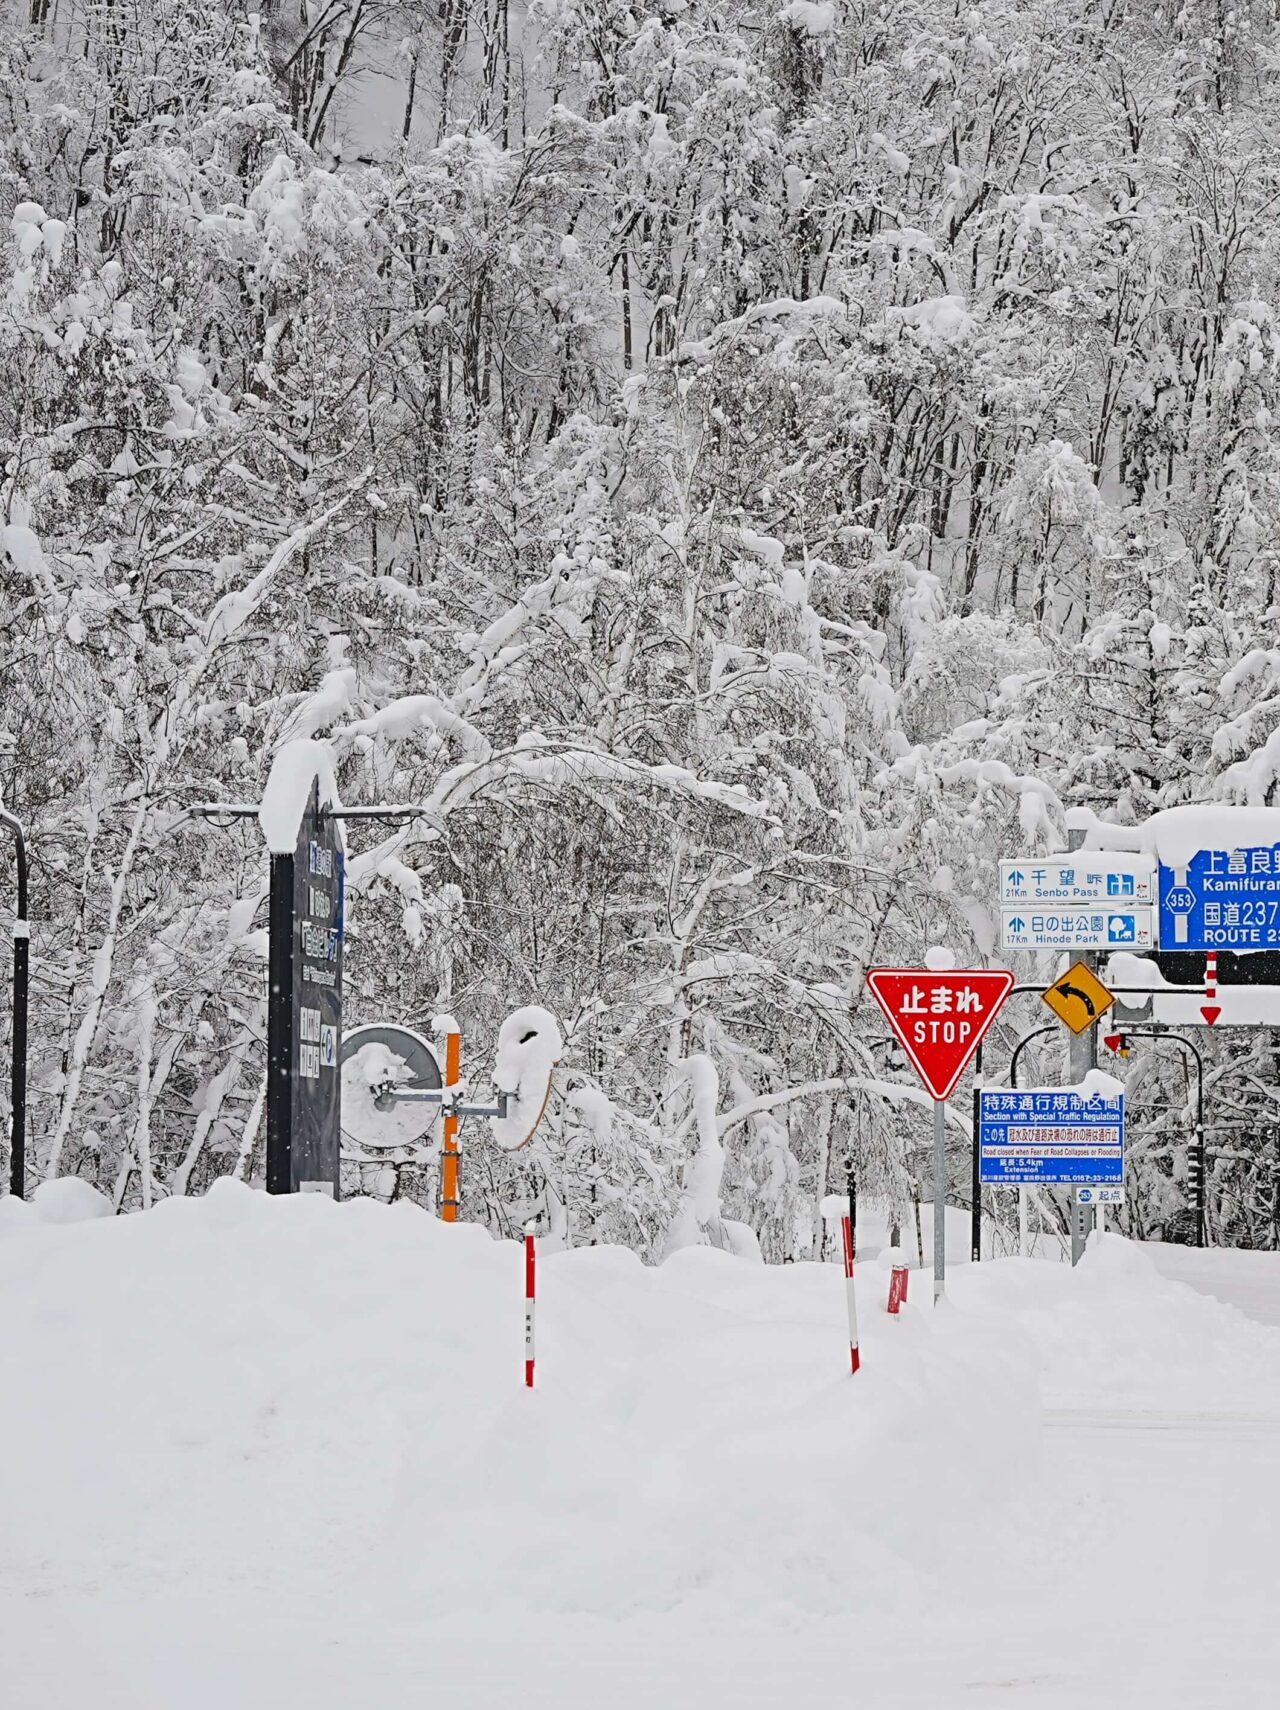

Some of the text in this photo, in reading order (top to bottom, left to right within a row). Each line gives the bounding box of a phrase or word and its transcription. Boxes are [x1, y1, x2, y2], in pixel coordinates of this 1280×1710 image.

[1031, 869, 1103, 886] 千望峠
[1006, 888, 1099, 897] 21Km Senbo Pass
[1169, 894, 1192, 907] 353
[1032, 916, 1104, 932] 日の出公園
[1007, 934, 1099, 943] 17Km Hinode Park
[1204, 929, 1261, 942] ROUTE
[899, 985, 984, 1014] 止まれ
[914, 1021, 972, 1044] STOP
[984, 1095, 1121, 1111] 特殊通行規制区間
[984, 1112, 1120, 1122] Section with Special Traffic Regulation
[984, 1128, 1005, 1143] この先
[983, 1147, 1120, 1157] Road closed when Fear of Road Collapses or Flooding
[1098, 1190, 1121, 1201] 起点
